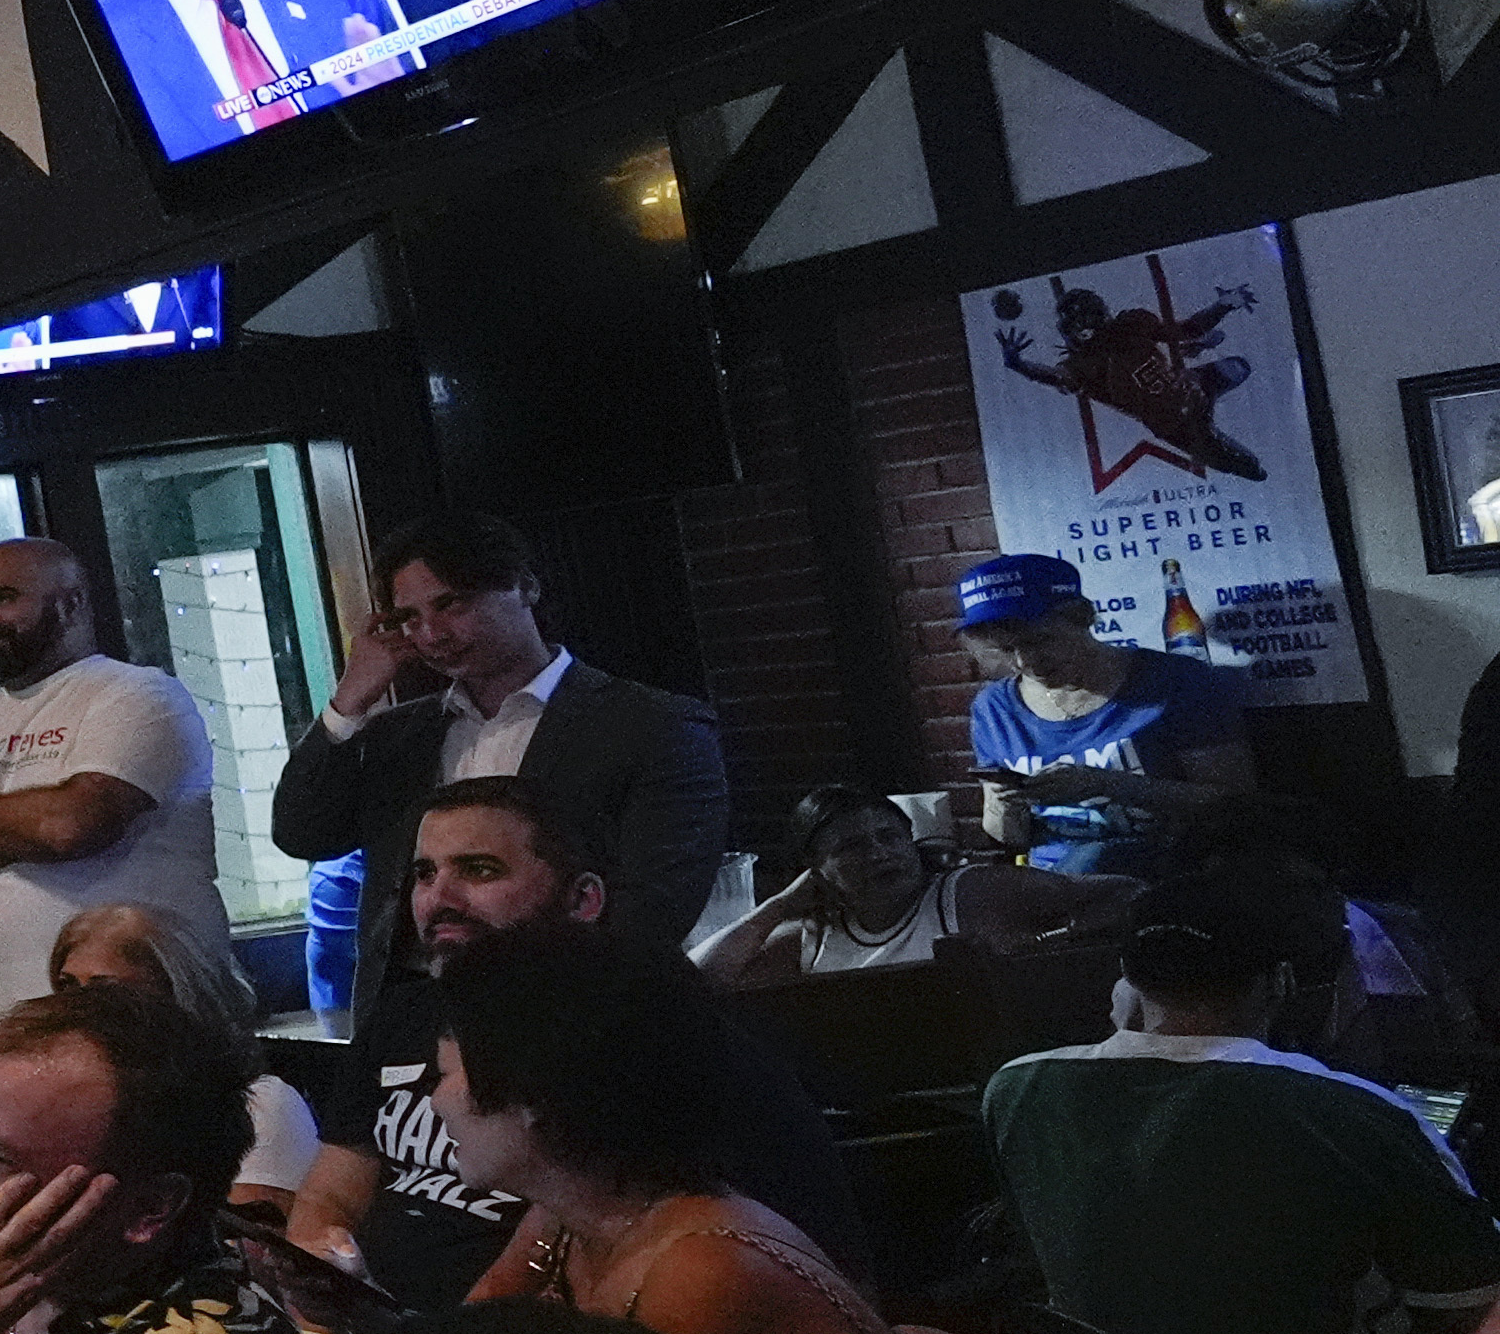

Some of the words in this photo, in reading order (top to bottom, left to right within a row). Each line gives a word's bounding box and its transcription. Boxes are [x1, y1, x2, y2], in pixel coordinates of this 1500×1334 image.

[218, 93, 252, 119] LIVE
[271, 70, 312, 98] NEWS
[331, 52, 364, 75] 2024
[366, 11, 469, 60] PRESIDENTIAL
[1068, 502, 1246, 540] SUPERIOR
[1187, 525, 1272, 551] BEER
[1216, 582, 1284, 606] DURING
[1286, 579, 1323, 599] NFL
[1214, 610, 1251, 632] AND
[1254, 603, 1338, 629] COLLEGE
[1230, 631, 1328, 656] FOOTBALL
[384, 1165, 523, 1222] WALZ
